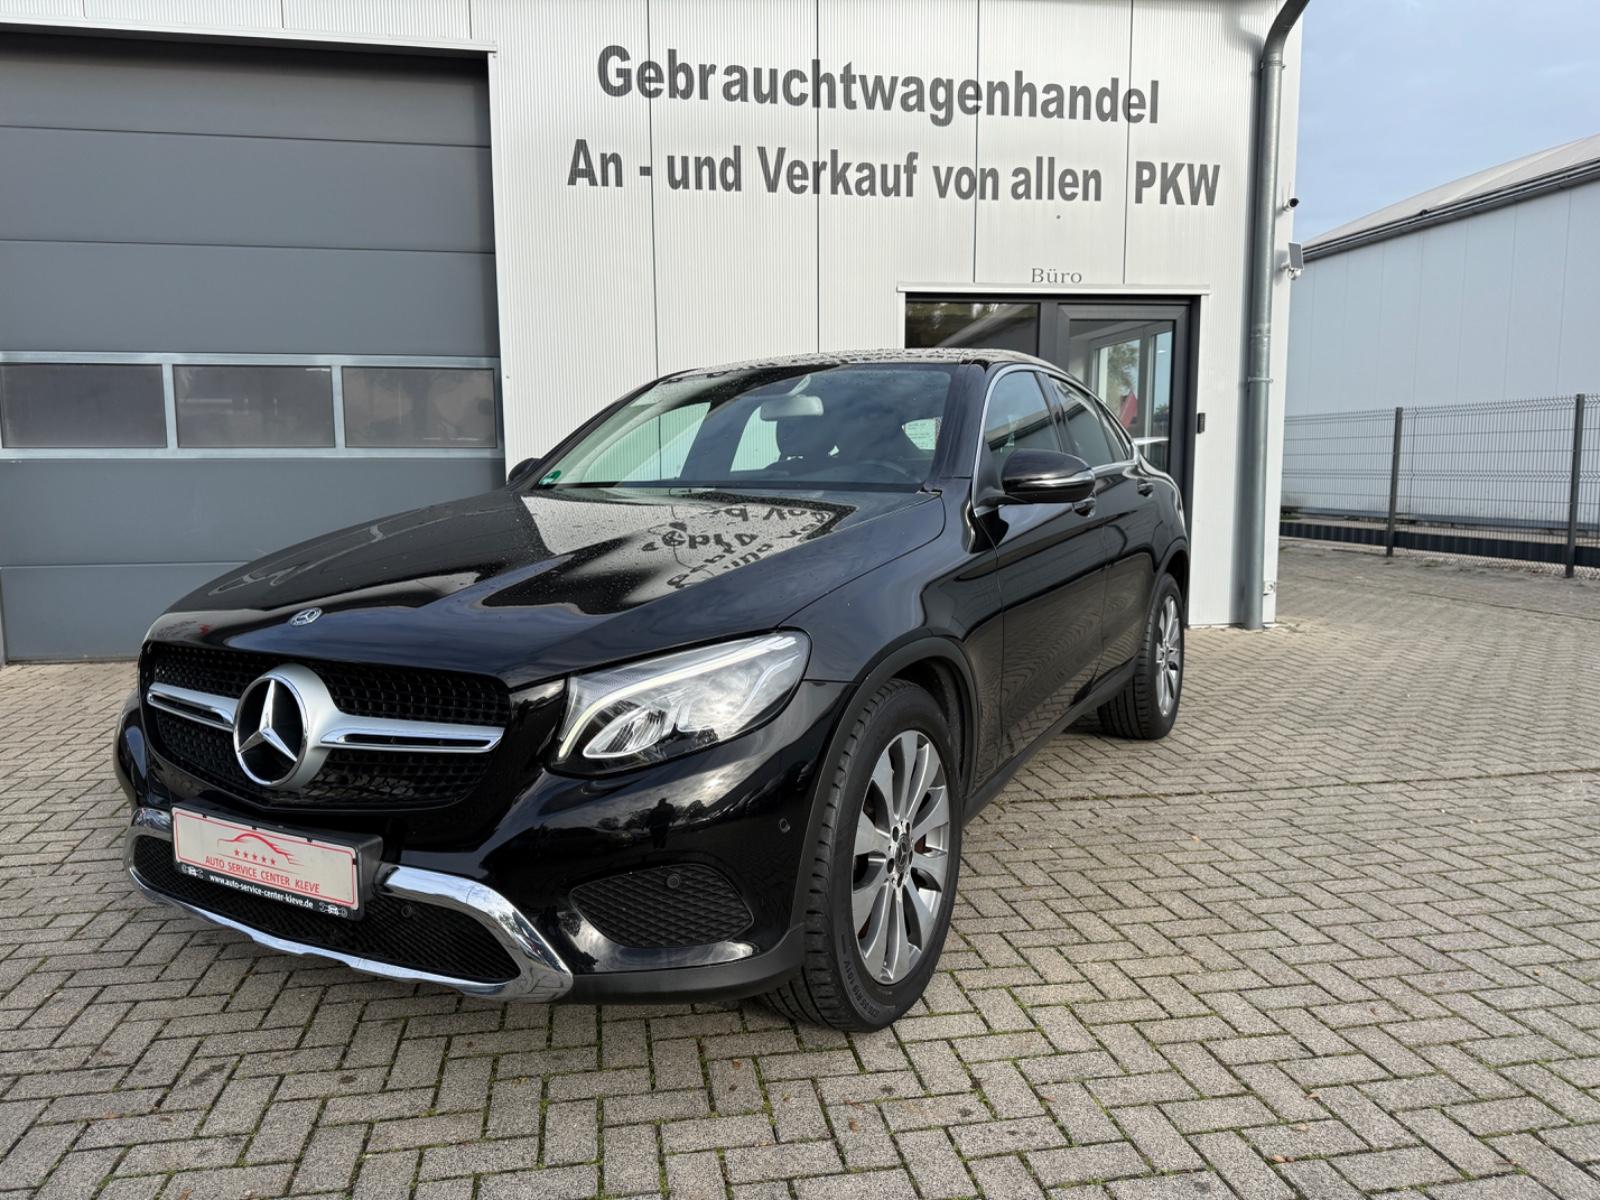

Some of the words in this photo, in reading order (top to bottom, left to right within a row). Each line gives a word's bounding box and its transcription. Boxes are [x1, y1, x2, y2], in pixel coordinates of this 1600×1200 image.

[597, 45, 1159, 127] Gebrauchtwagenhandel
[567, 138, 623, 188] An
[639, 166, 652, 176] -
[667, 145, 742, 192] und
[757, 146, 918, 197] Verkauf
[933, 165, 999, 201] von
[1011, 156, 1102, 202] allen
[1135, 161, 1221, 206] PKW
[1031, 267, 1082, 284] Büro
[205, 856, 224, 868] AUTO
[228, 862, 257, 877] SERVICE
[260, 871, 290, 885] CENTER
[295, 879, 320, 893] KLEVE
[209, 874, 313, 908] www.auto-service-center-kleve.de
